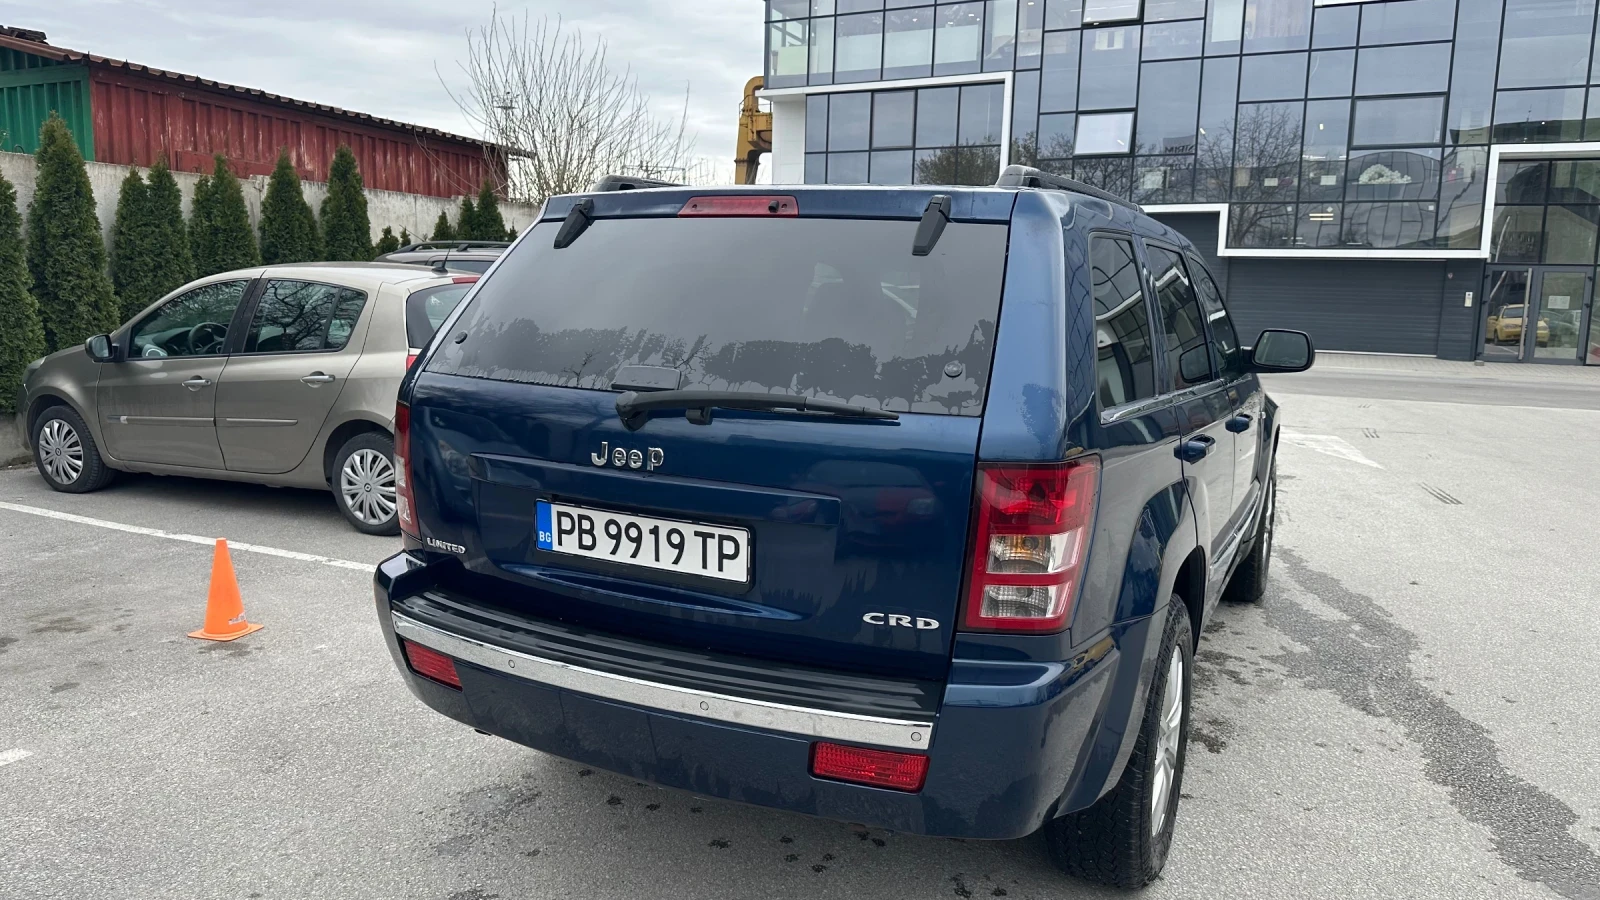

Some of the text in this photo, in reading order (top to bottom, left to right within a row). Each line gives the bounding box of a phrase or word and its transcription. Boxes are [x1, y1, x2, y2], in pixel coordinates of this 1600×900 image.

[591, 441, 664, 471] Jeep
[426, 537, 466, 554] LIMITED
[539, 531, 552, 543] BG
[556, 510, 741, 572] PB 9919 TP
[862, 612, 940, 630] CRD
